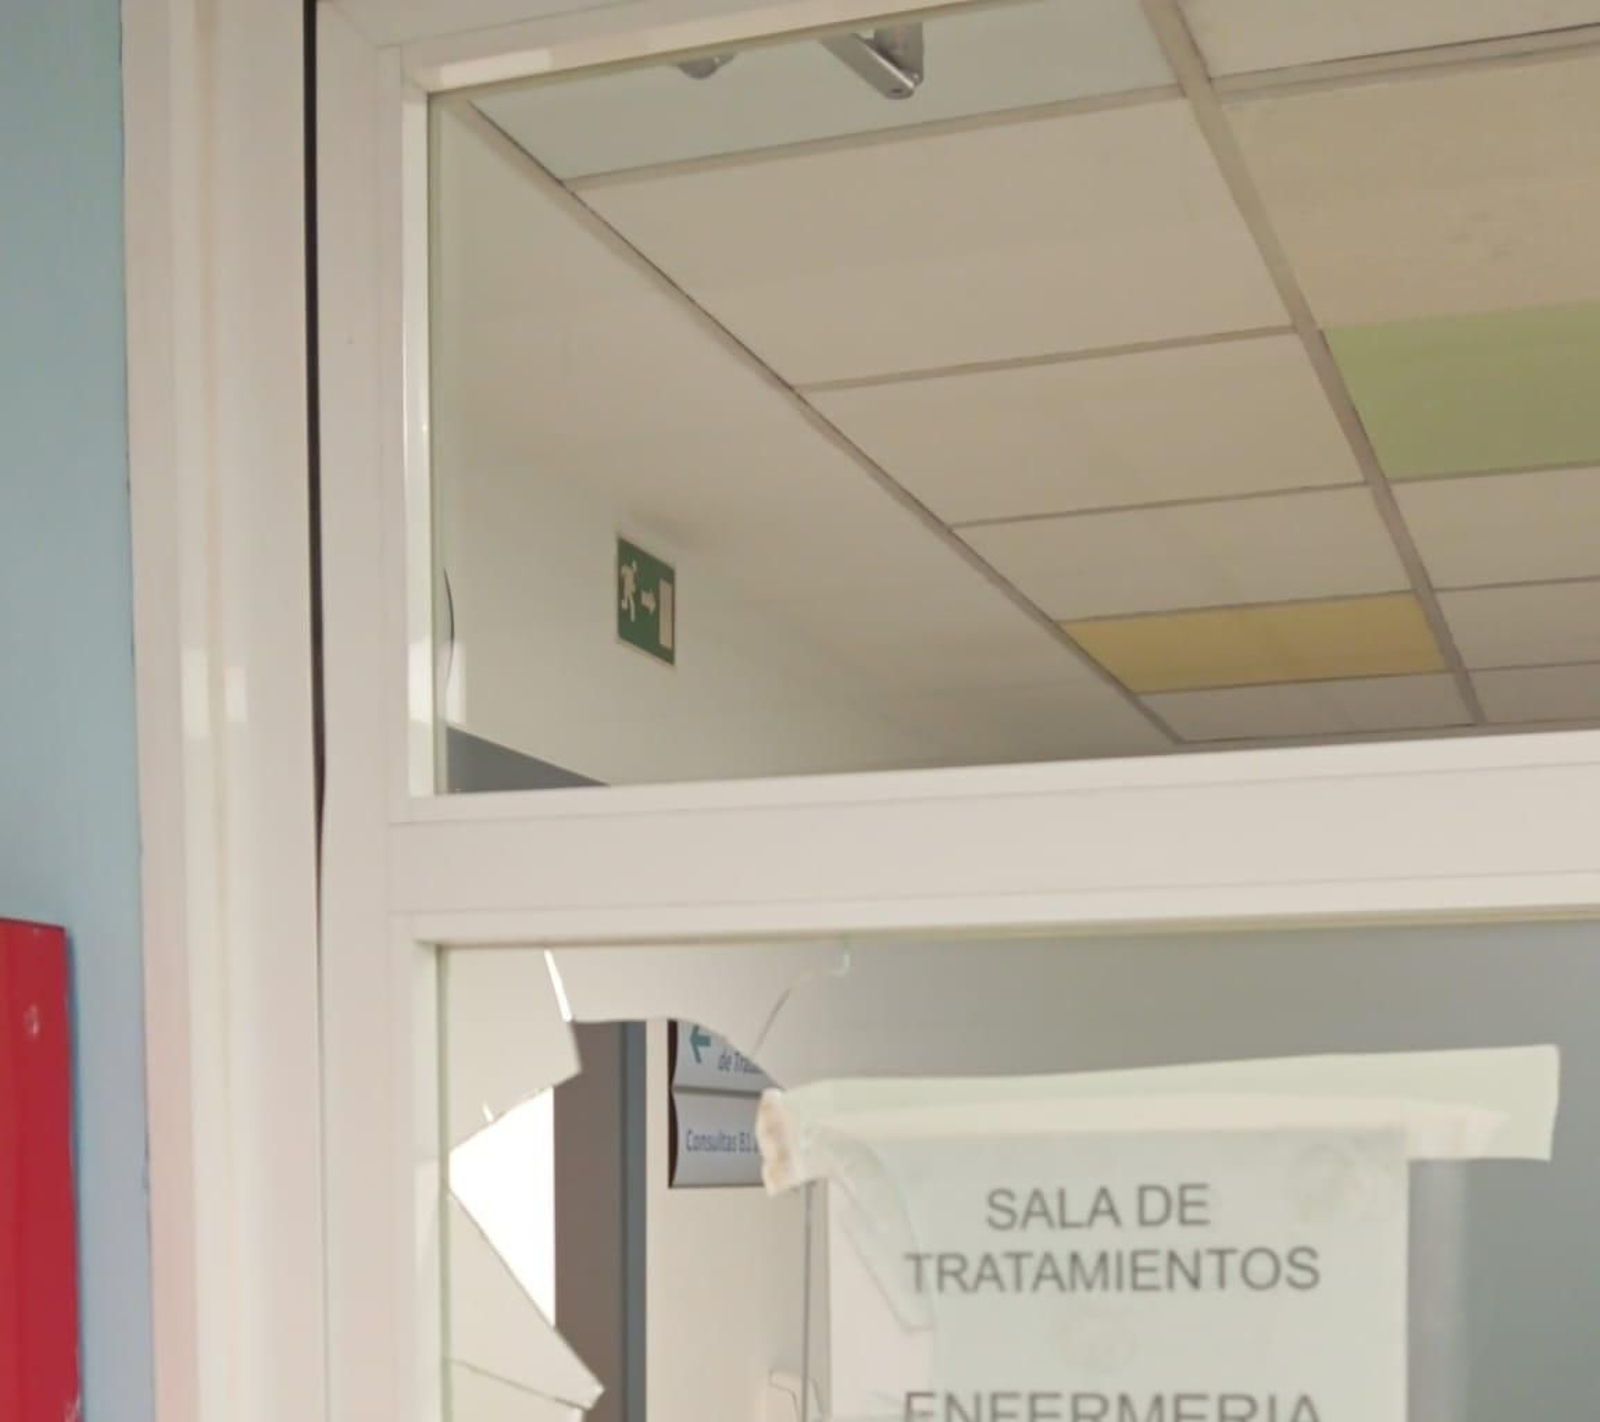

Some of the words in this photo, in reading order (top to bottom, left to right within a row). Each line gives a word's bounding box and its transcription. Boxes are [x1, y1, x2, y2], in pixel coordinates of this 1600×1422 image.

[685, 1129, 736, 1152] Consultas
[986, 1184, 1122, 1231] SALA
[1137, 1183, 1211, 1228] DE
[903, 1246, 1321, 1294] TRATAMIENTOS
